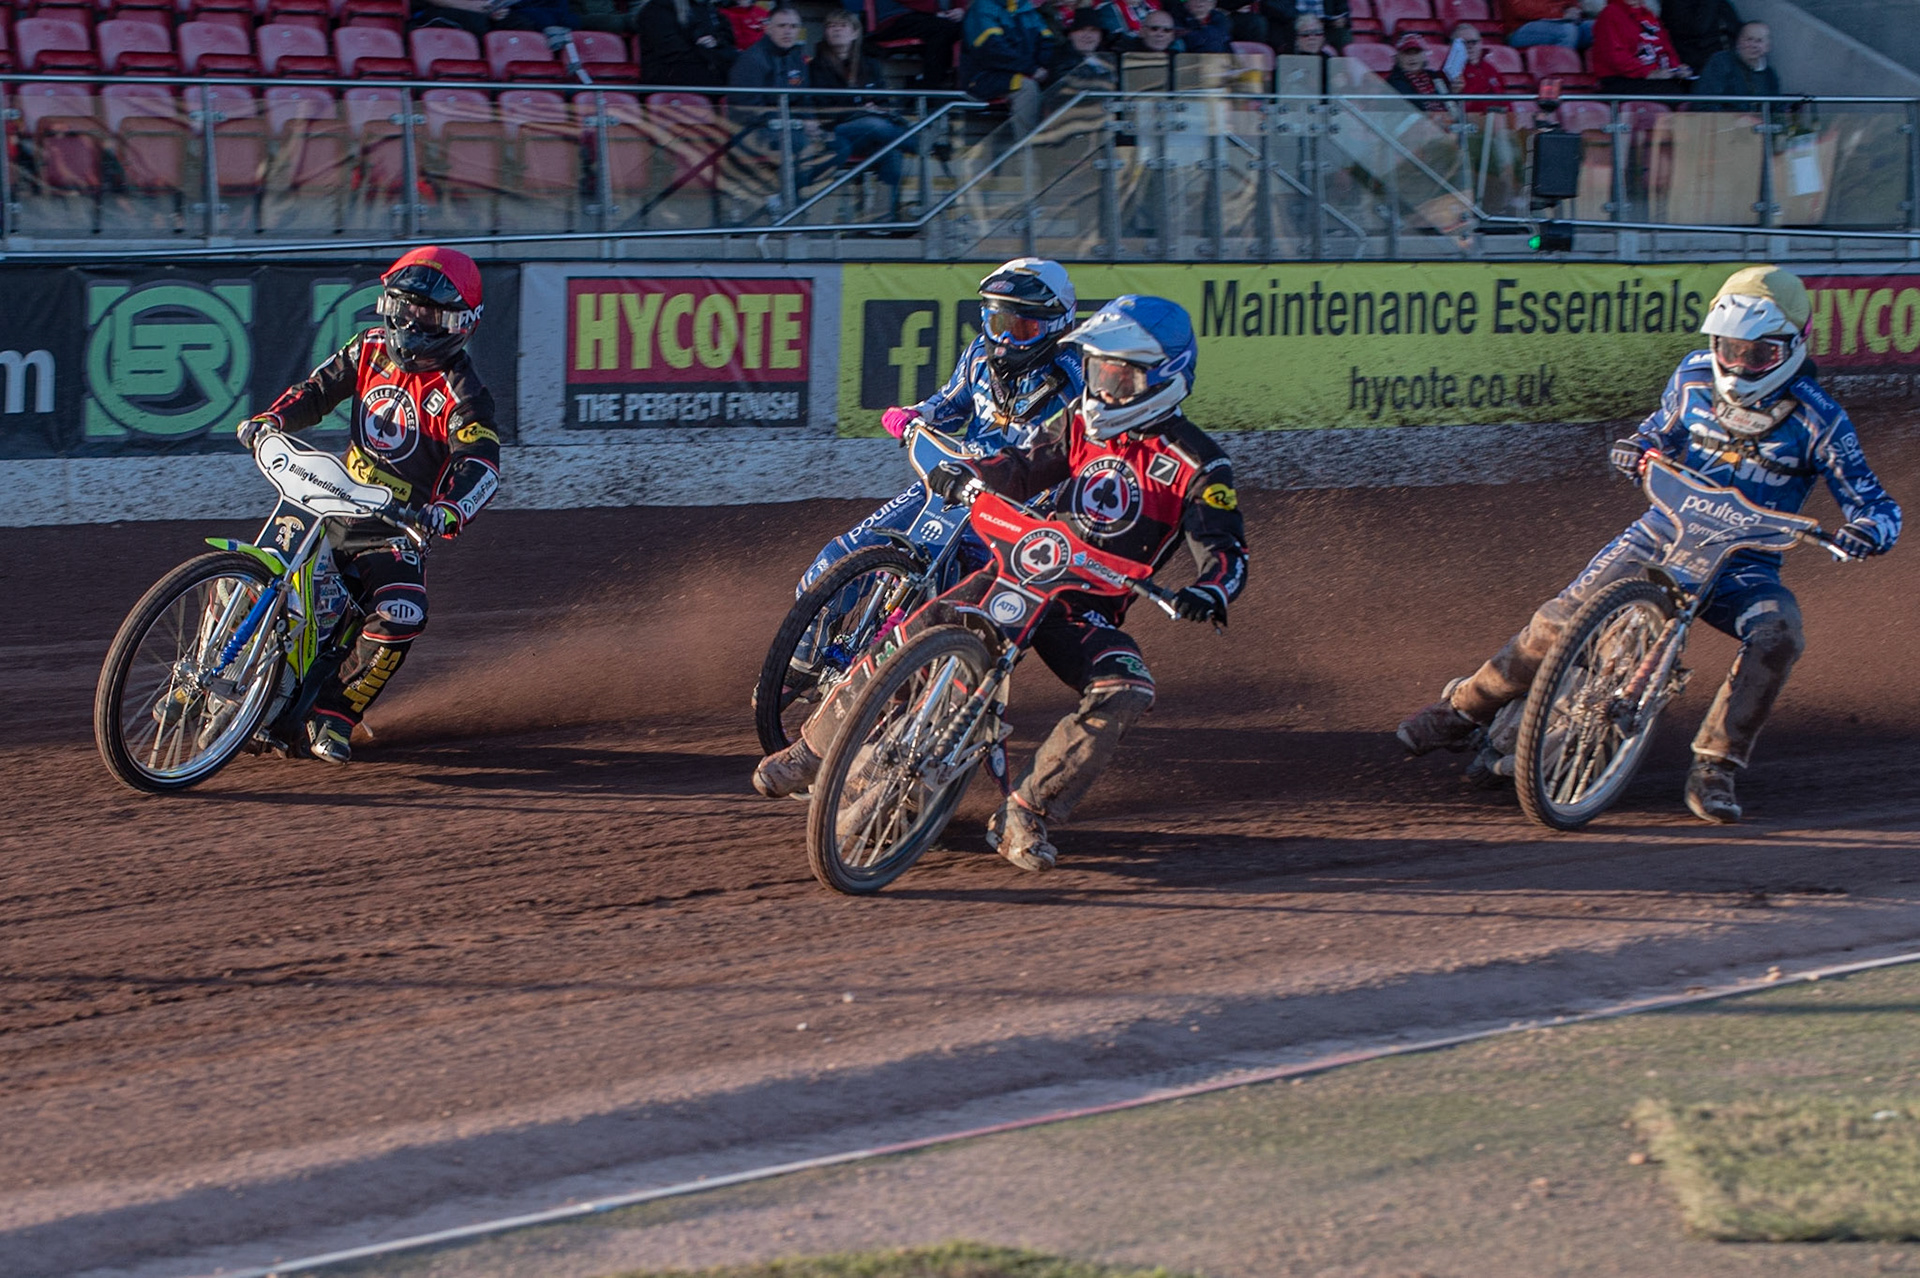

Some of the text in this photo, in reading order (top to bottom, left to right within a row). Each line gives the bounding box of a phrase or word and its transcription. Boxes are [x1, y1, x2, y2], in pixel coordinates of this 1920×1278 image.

[575, 292, 804, 370] HYCOTE
[1201, 278, 1701, 337] Maintenance Essentials
[575, 391, 799, 422] THE PERFECT FINISH
[1348, 364, 1556, 419] hycote.co.uk
[848, 482, 921, 544] poultec
[1679, 494, 1758, 528] poultec
[996, 601, 1019, 615] ATPI
